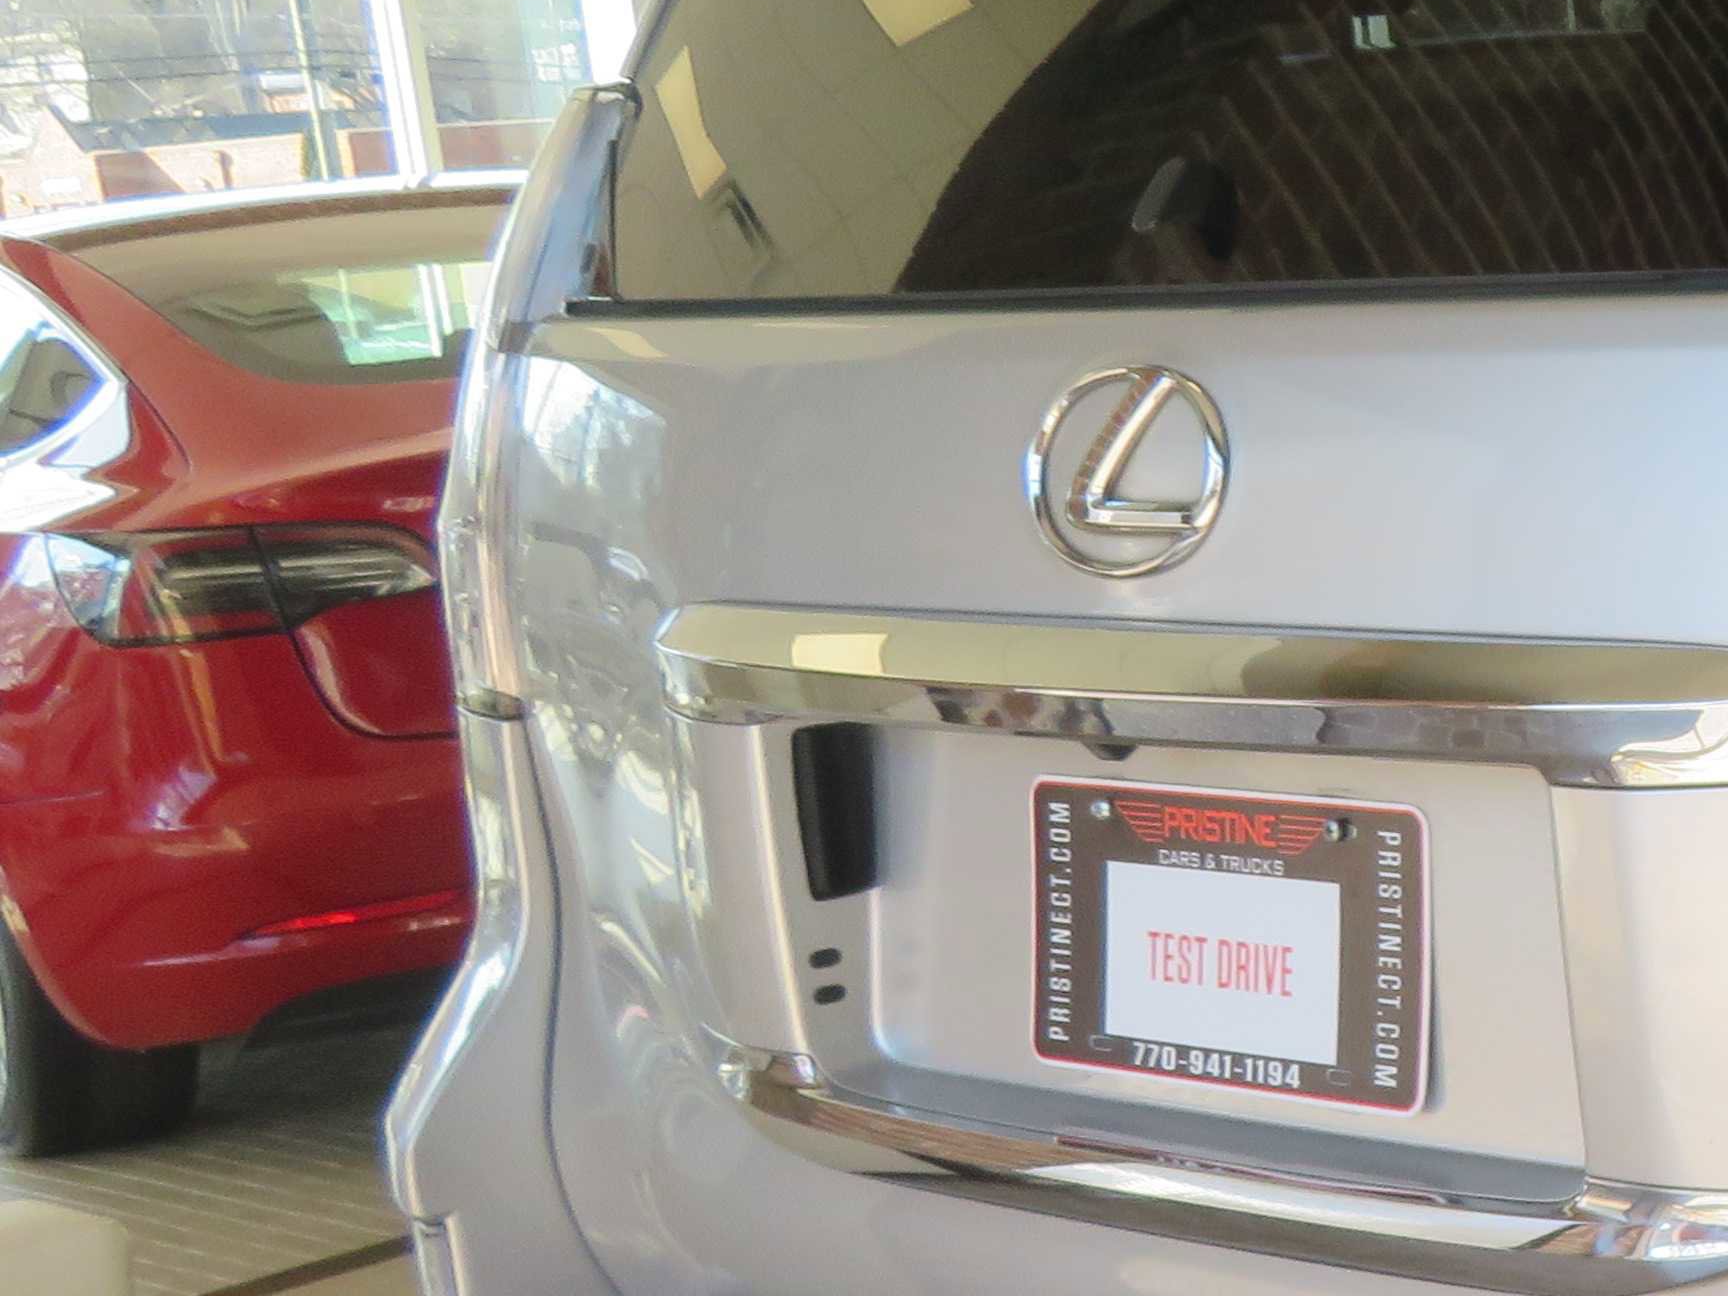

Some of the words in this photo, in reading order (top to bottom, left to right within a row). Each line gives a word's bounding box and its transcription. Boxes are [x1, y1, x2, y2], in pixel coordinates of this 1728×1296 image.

[1163, 806, 1280, 848] PRISTINE
[1158, 848, 1201, 868] CARS
[1205, 853, 1217, 870] &
[1220, 854, 1285, 877] TRUCKS
[1048, 802, 1073, 1042] PRISTINECT.COM
[1148, 931, 1208, 985] TEST
[1217, 939, 1294, 997] DRIVE
[1374, 830, 1402, 1089] PRISTINECT.COM
[1132, 1042, 1301, 1089] 770-941-1194
